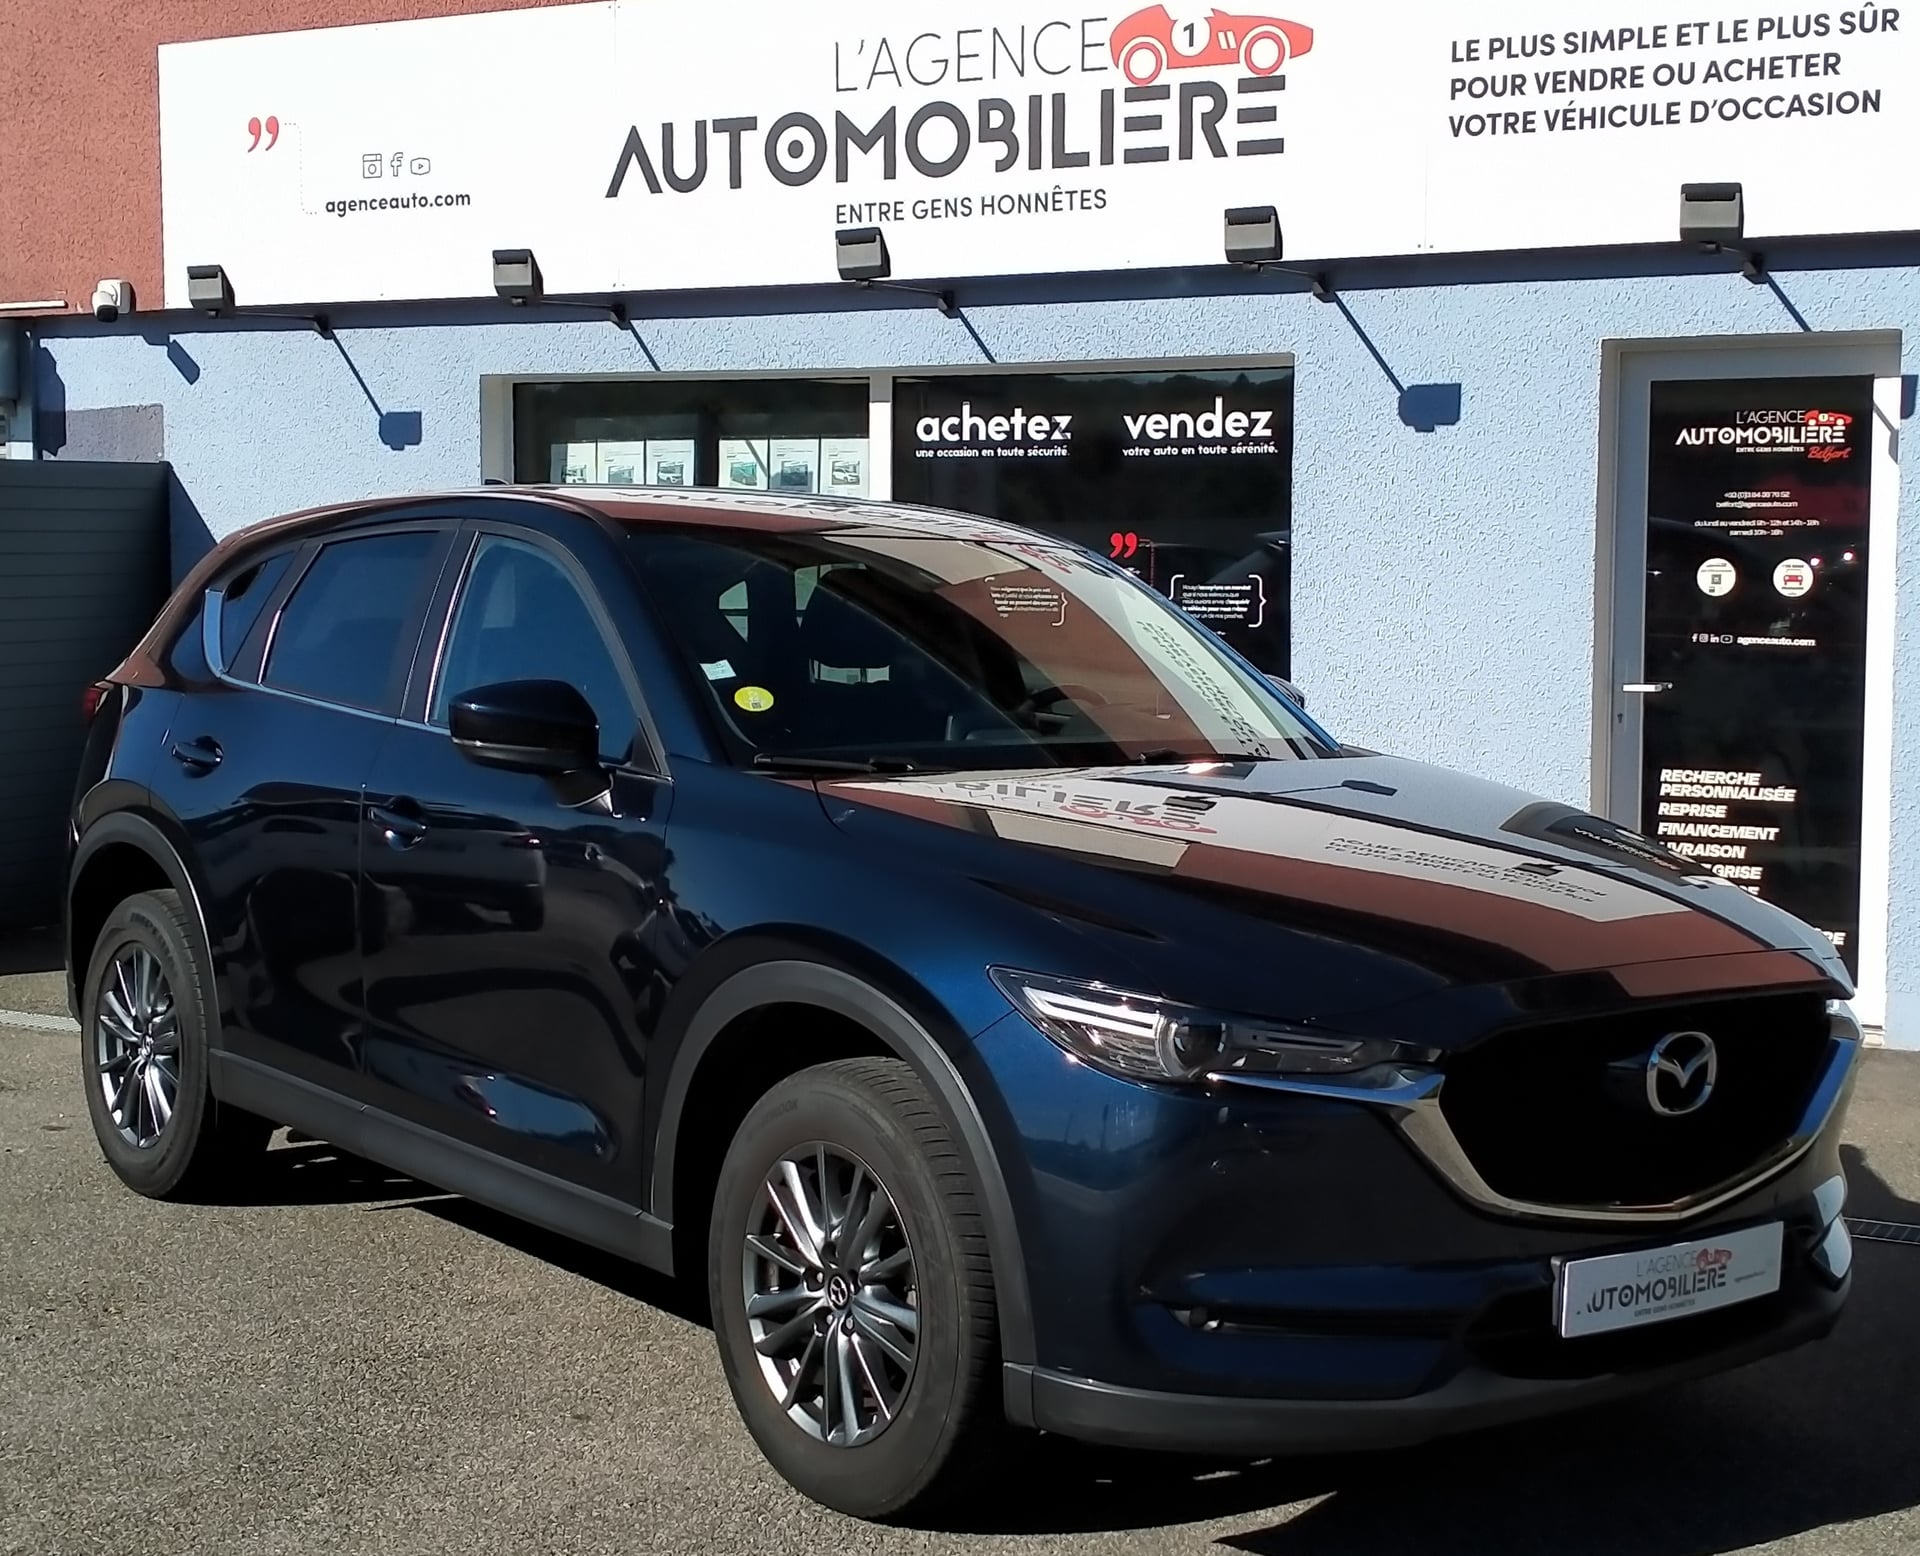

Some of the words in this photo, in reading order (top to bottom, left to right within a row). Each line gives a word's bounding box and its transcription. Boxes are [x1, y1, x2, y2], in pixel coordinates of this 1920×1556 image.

[1452, 40, 1480, 62] LE
[1488, 34, 1555, 60] PLUS
[1563, 24, 1667, 55] SIMPLE
[1676, 22, 1709, 46] ET
[1717, 19, 1748, 43] LE
[1757, 13, 1831, 41] PLUS
[1839, 2, 1900, 33] SÛR
[835, 17, 1108, 93] L'AGENCE
[1450, 74, 1526, 100] POUR
[1534, 65, 1645, 95] VENDRE
[1653, 62, 1696, 86] OU
[1702, 53, 1841, 84] ACHETER
[1449, 110, 1537, 137] VOTRE
[1544, 101, 1681, 132] VÉHICULE
[1690, 89, 1881, 124] D'OCCASION
[325, 192, 471, 217] agenceauto.com
[836, 202, 905, 225] ENTRE
[912, 197, 973, 220] GENS
[981, 185, 1107, 216] HONNÊTES
[916, 401, 1072, 441] achetez
[1123, 396, 1273, 439] vendez
[1737, 410, 1806, 424] L'AGENCE
[916, 449, 934, 457] une
[936, 446, 980, 458] occasion
[981, 449, 995, 457] en
[996, 446, 1025, 457] toute
[1122, 446, 1151, 457] votre
[1153, 445, 1179, 456] auto
[1181, 446, 1196, 455] en
[1198, 444, 1228, 455] toute
[1660, 769, 1761, 786] RECHERCHE
[1659, 784, 1797, 802] PERSONNALISÉE
[1657, 802, 1728, 818] REPRISE
[1657, 822, 1780, 841] FINANCEMENT
[1659, 841, 1747, 859] IVRAISON
